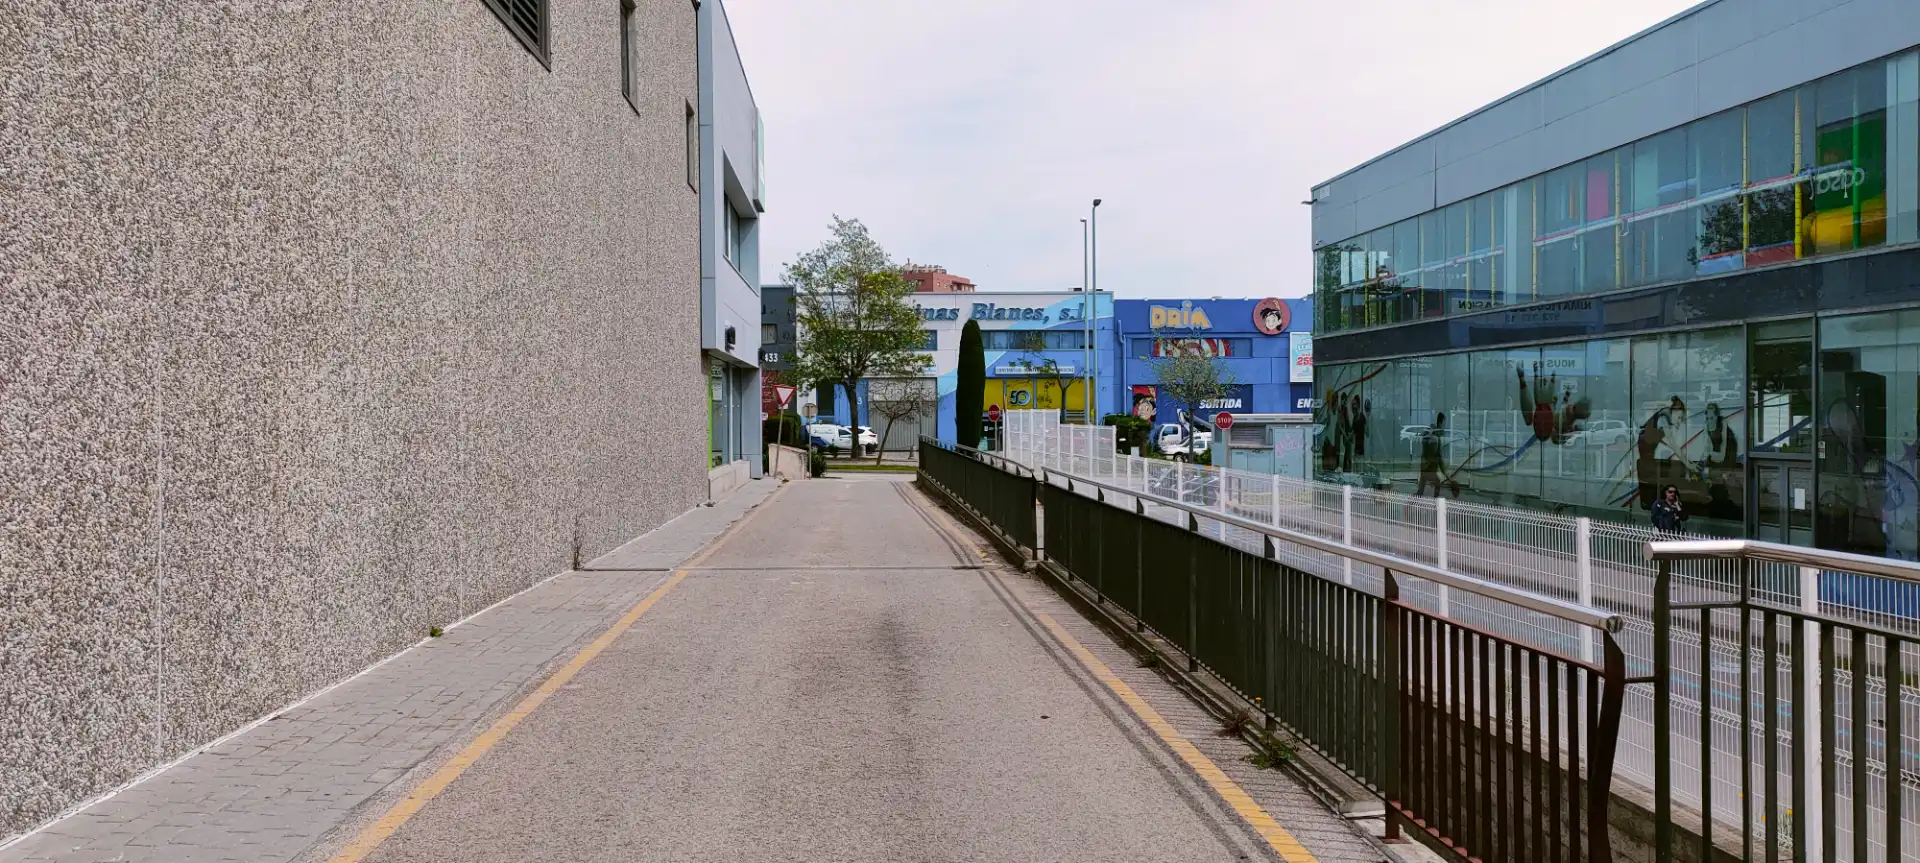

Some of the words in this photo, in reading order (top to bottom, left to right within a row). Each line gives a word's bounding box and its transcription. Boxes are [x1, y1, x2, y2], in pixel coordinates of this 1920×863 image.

[914, 304, 960, 322] inas
[970, 303, 1049, 324] Blanes,
[764, 352, 778, 362] 433
[1009, 390, 1031, 406] 50
[1199, 398, 1242, 409] SORTIDA
